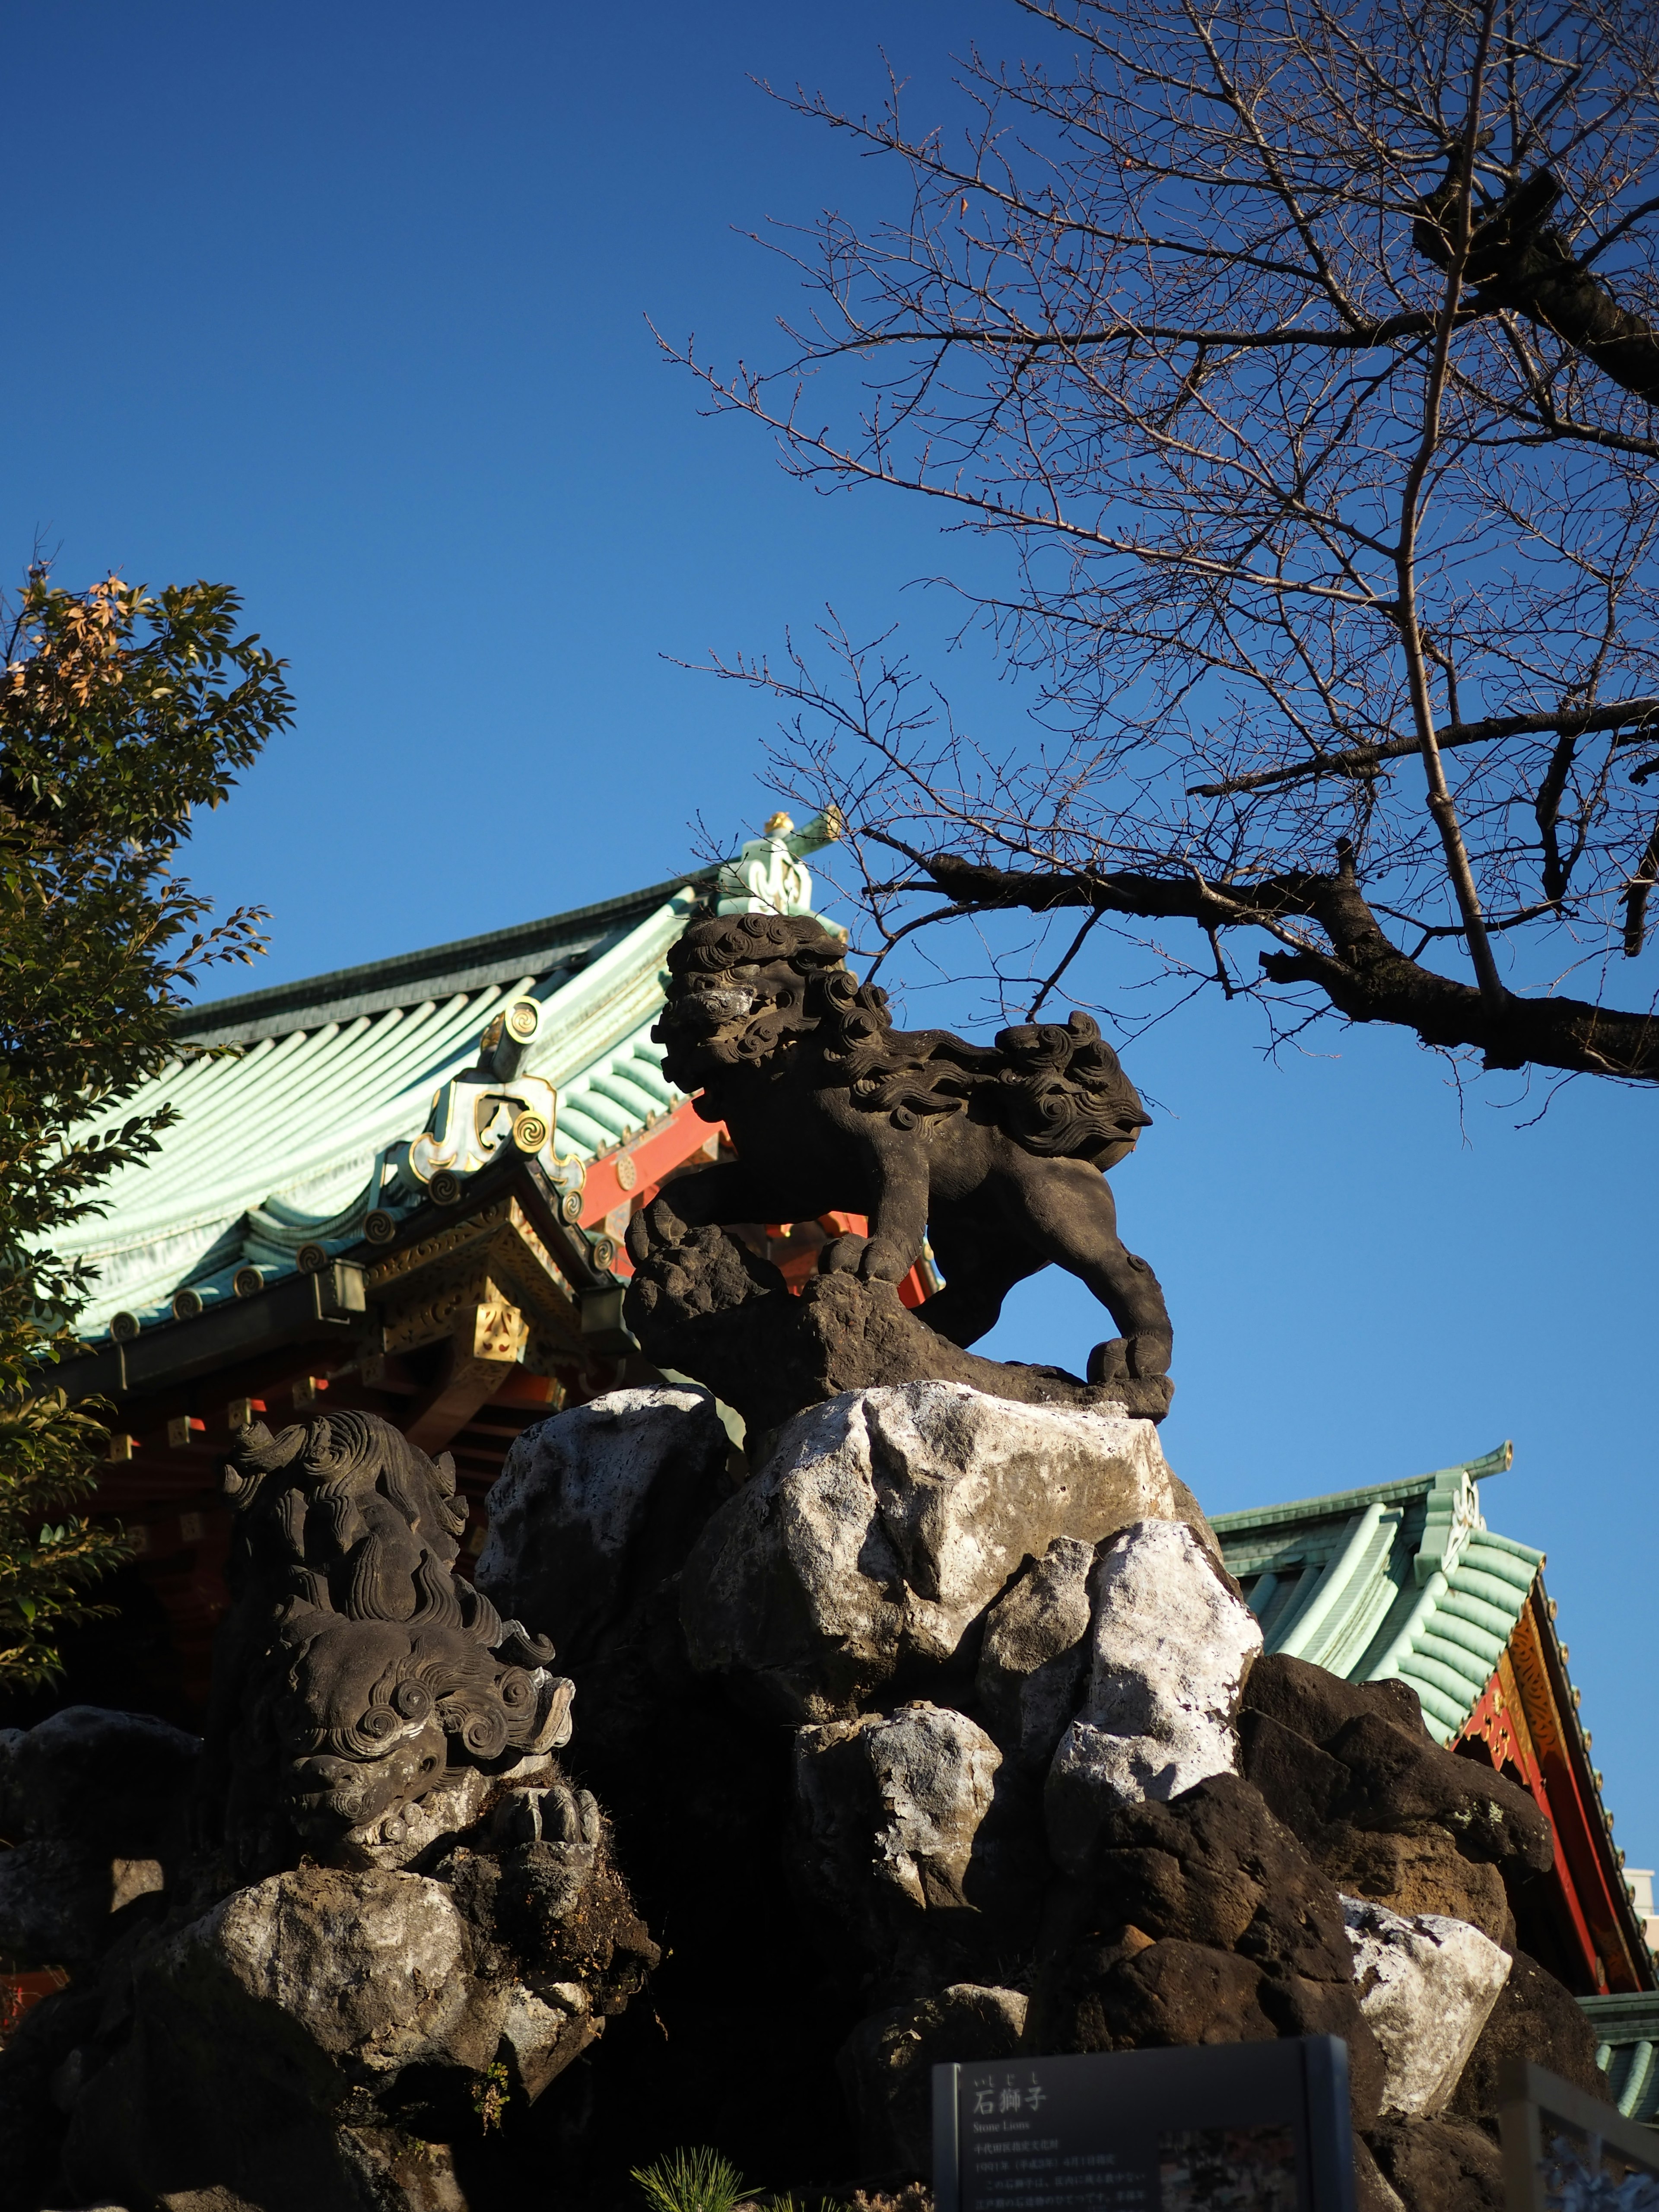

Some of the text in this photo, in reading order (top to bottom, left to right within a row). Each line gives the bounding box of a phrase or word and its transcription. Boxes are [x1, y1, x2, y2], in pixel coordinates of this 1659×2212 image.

[973, 2086, 1046, 2115] 石獅子
[973, 2120, 1030, 2133] Stone Lions
[974, 2138, 1058, 2155] 千代田区指定文化財
